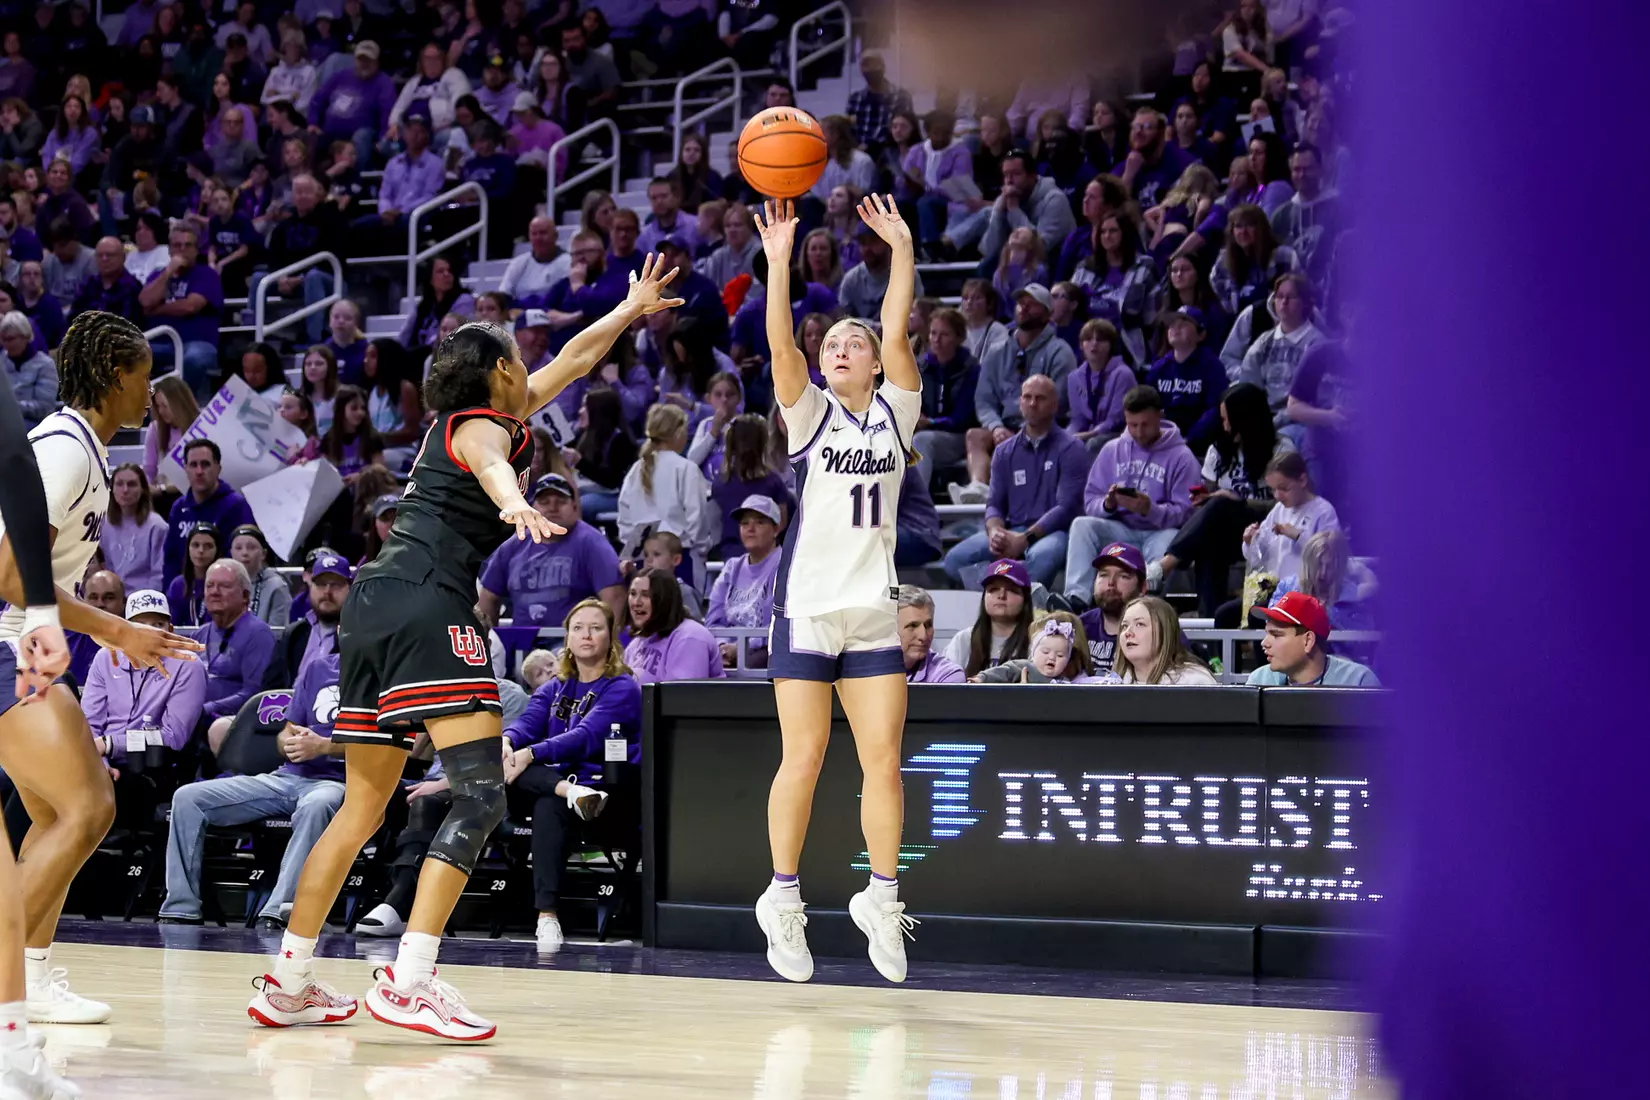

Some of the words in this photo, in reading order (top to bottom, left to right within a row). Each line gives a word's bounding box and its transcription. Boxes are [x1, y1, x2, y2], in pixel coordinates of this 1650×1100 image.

[171, 384, 235, 469] FTURE
[542, 412, 563, 444] 3
[821, 446, 897, 476] Wildcats
[849, 481, 883, 529] 11
[997, 771, 1369, 850] INTRUST
[127, 865, 143, 877] 26
[249, 869, 265, 880] 27
[347, 875, 364, 886] 28
[490, 879, 507, 891] 29
[598, 884, 614, 896] 30
